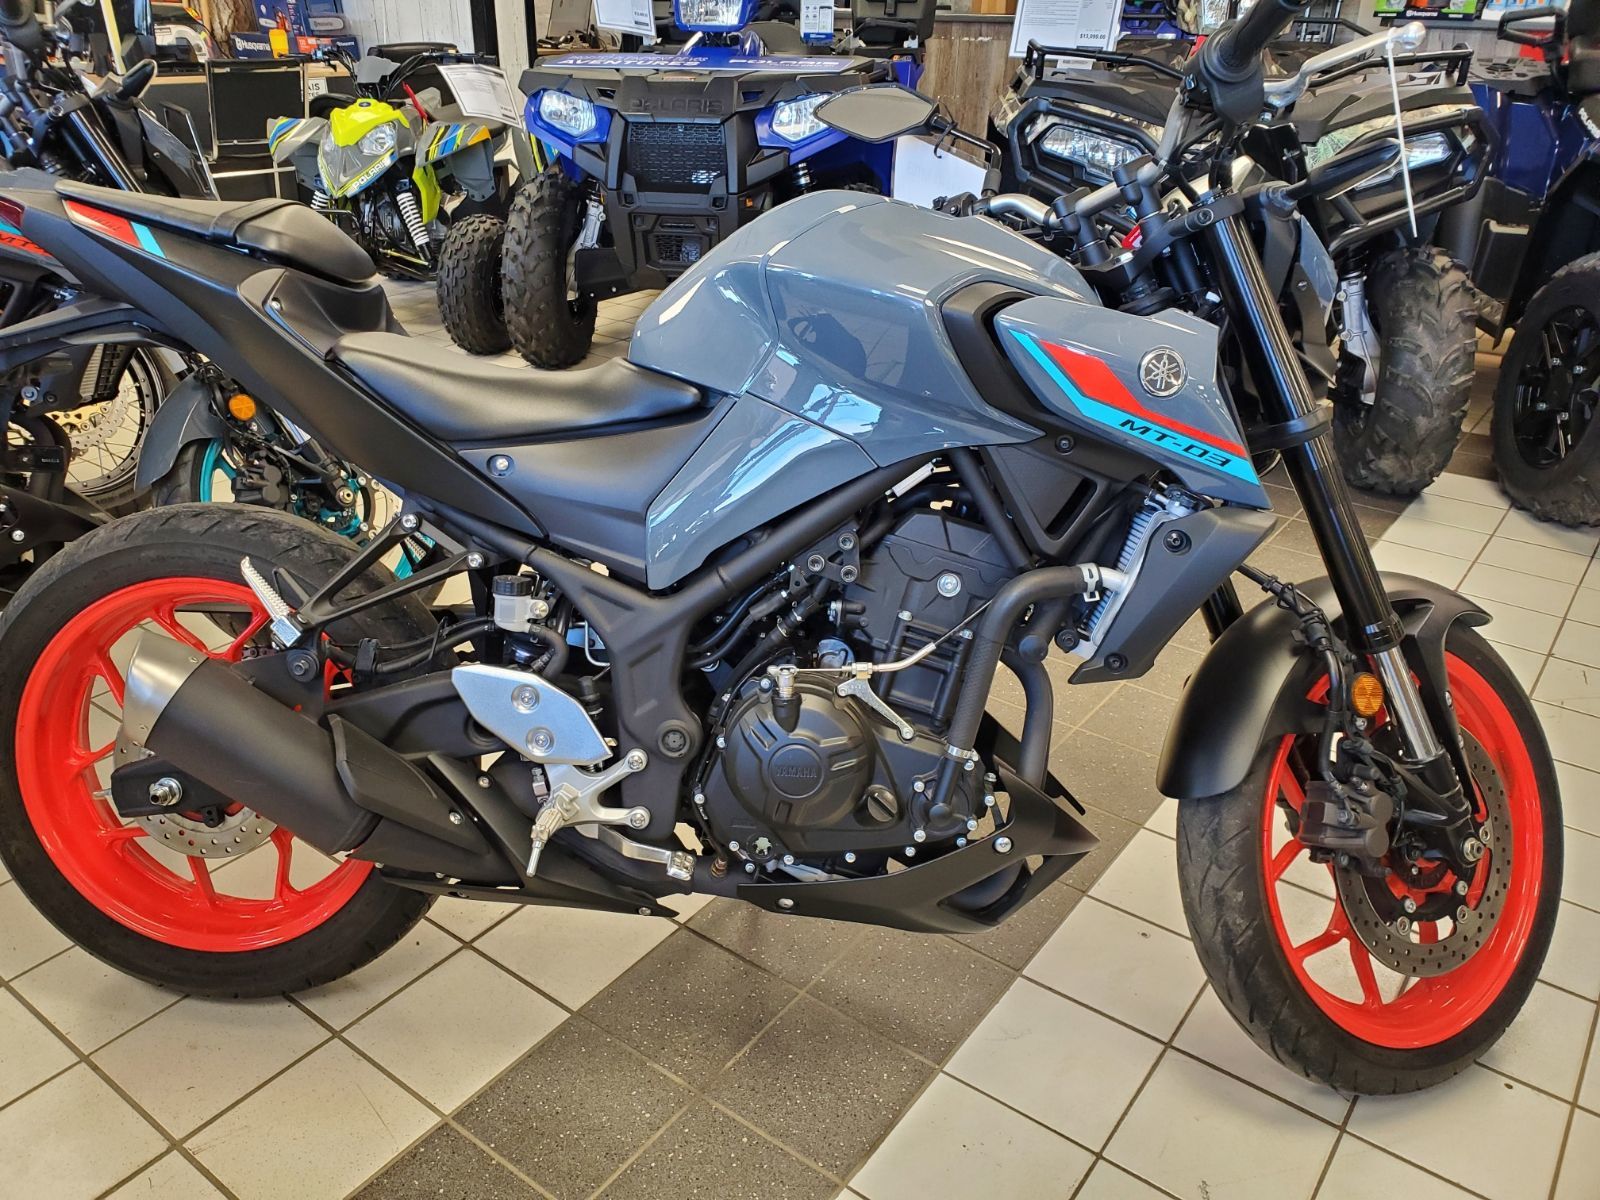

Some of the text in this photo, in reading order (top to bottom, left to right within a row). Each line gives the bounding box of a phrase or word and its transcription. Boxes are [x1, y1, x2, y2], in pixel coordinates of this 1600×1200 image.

[557, 59, 701, 67] AVENTURES
[631, 97, 724, 113] POLARIS
[351, 156, 391, 190] POLARIS
[1119, 417, 1232, 468] MT-03
[775, 766, 817, 778] YAMAHA
